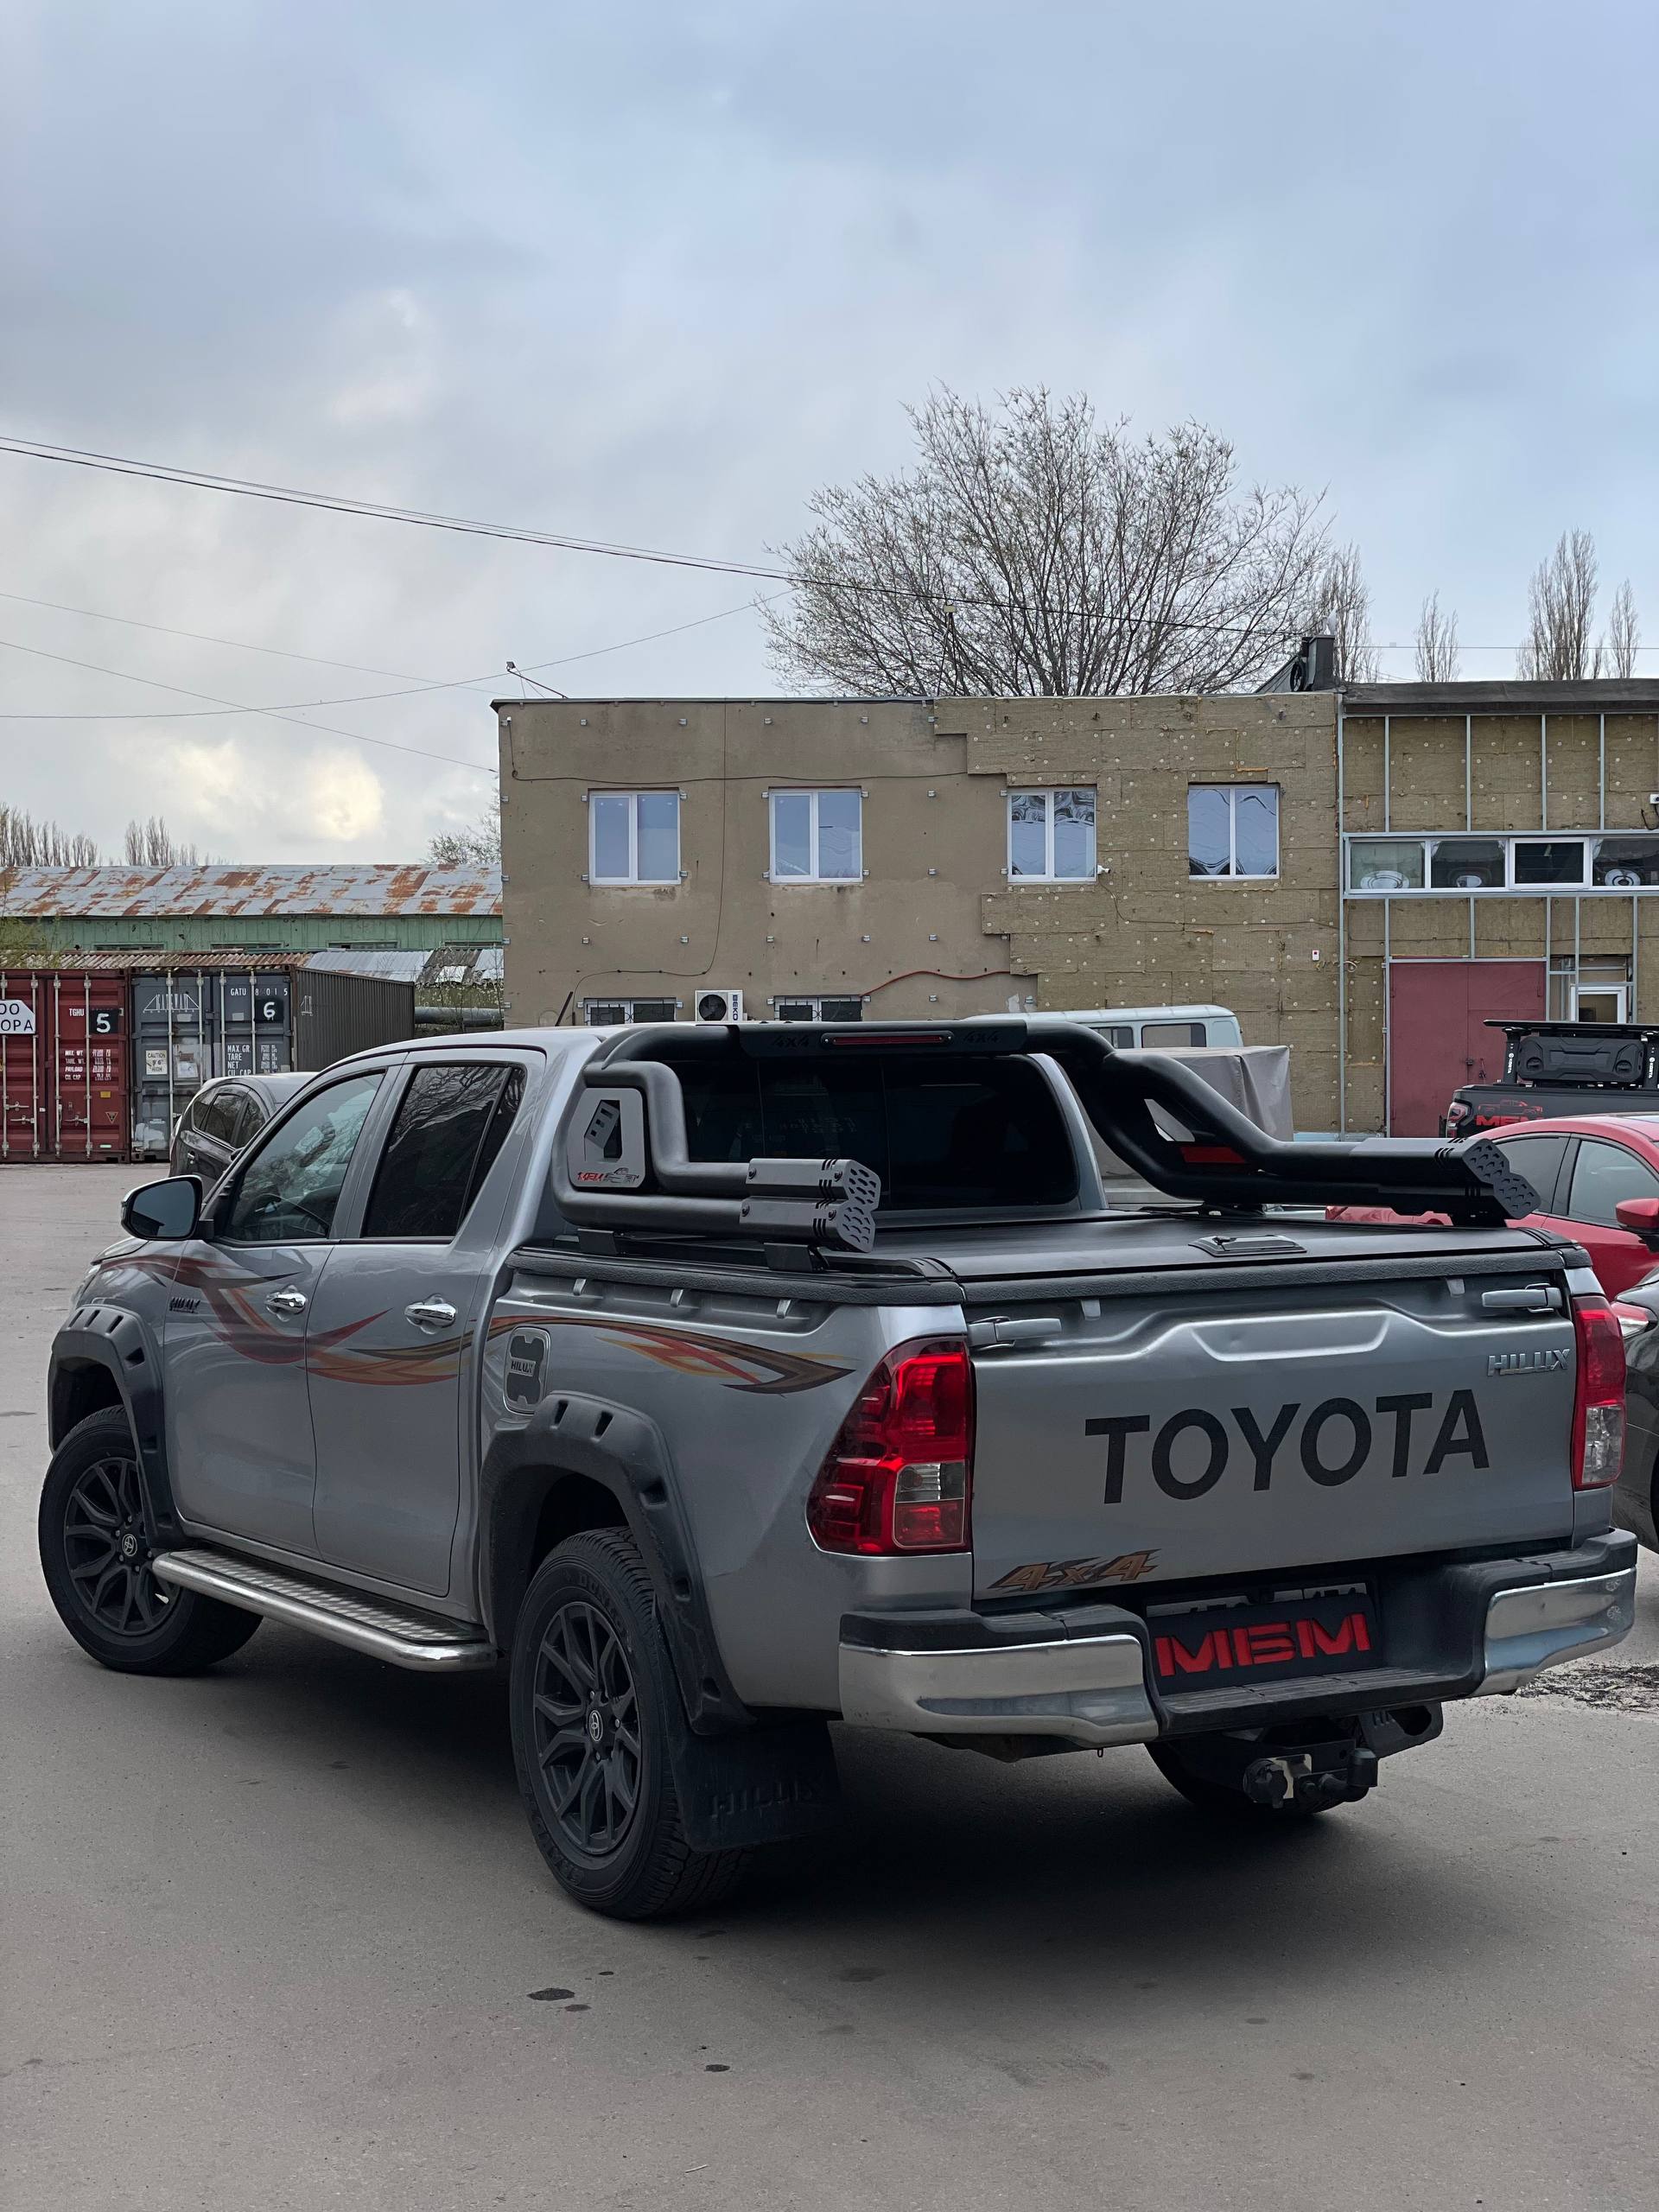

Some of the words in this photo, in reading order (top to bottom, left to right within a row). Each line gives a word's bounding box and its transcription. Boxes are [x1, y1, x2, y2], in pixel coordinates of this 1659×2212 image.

[230, 988, 247, 996] GATU
[68, 1007, 85, 1017] TGHU
[263, 1001, 276, 1018] 6
[96, 1013, 111, 1033] 5
[227, 1052, 243, 1061] TARE
[227, 1061, 239, 1070] NET
[511, 1360, 534, 1374] HILUX
[1487, 1348, 1571, 1376] HILUX
[1084, 1389, 1491, 1504] TOYOTA
